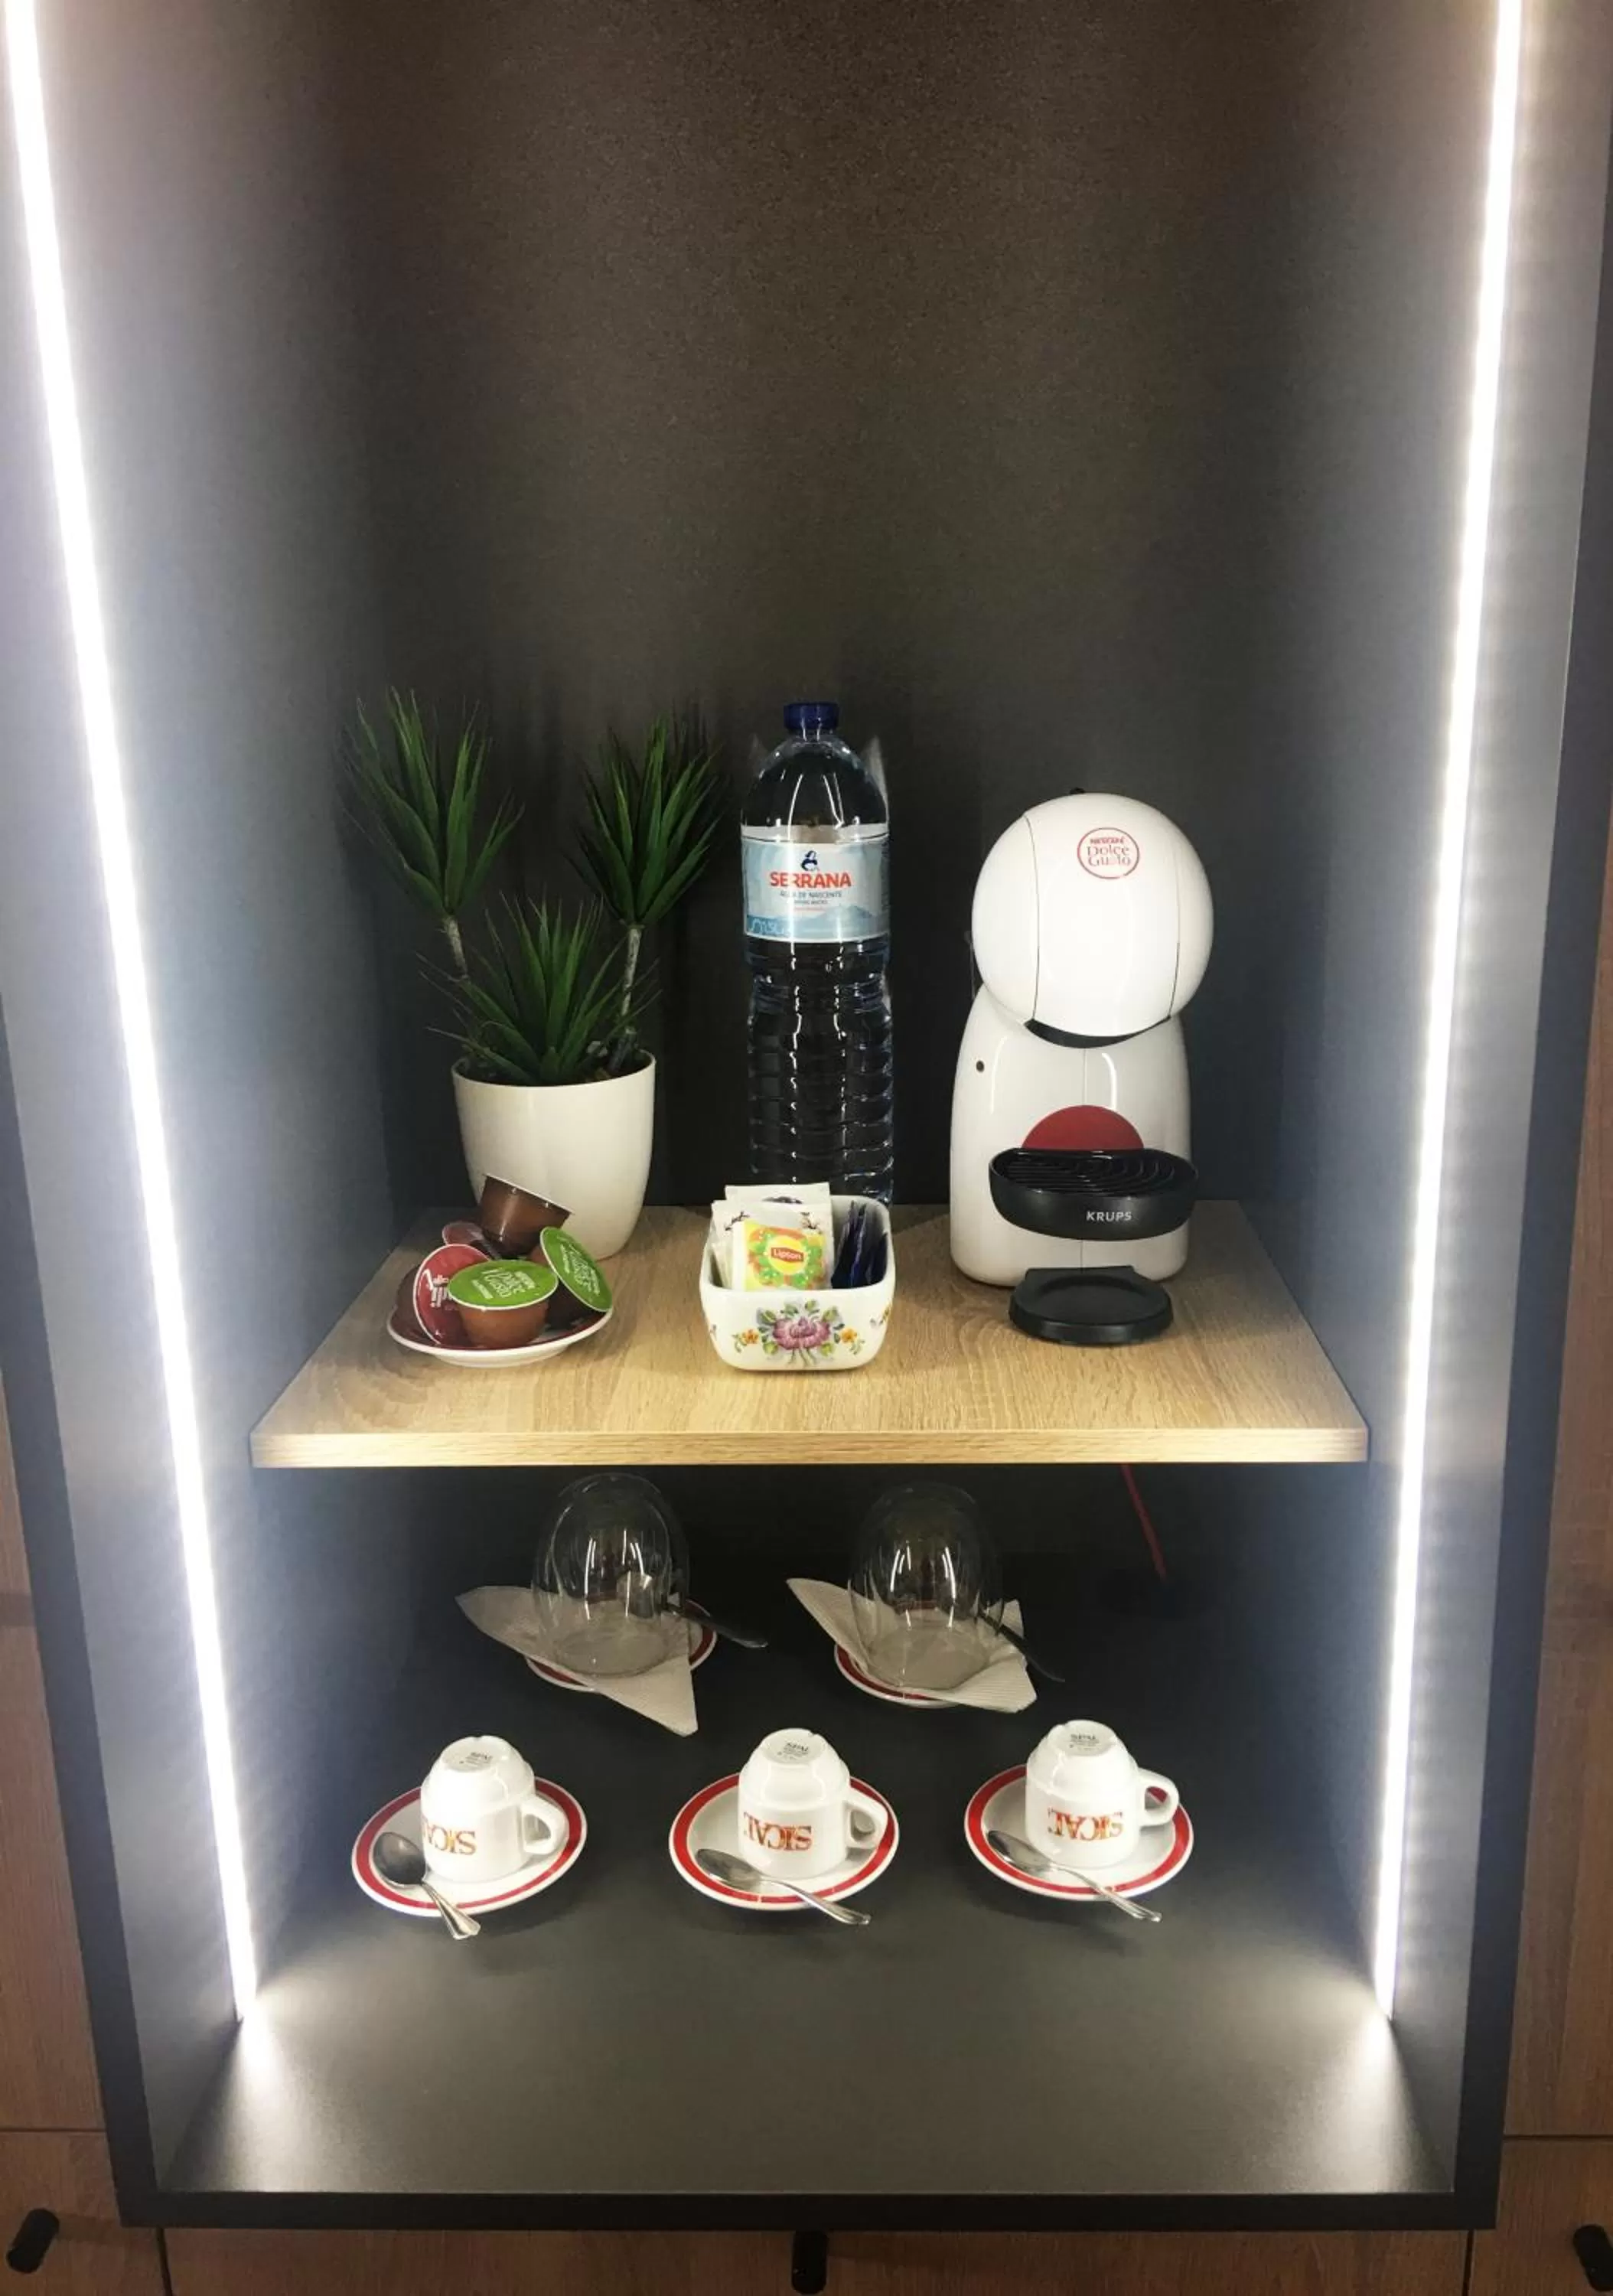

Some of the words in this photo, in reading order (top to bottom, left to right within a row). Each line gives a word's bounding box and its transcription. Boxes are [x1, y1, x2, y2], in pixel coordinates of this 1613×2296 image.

[770, 872, 852, 888] SERRANA
[1087, 1211, 1132, 1222] KRUPS
[774, 1248, 801, 1261] Lipton
[425, 1817, 477, 1856] SIC
[743, 1812, 813, 1851] SICAL
[1047, 1808, 1123, 1841] SICAL
